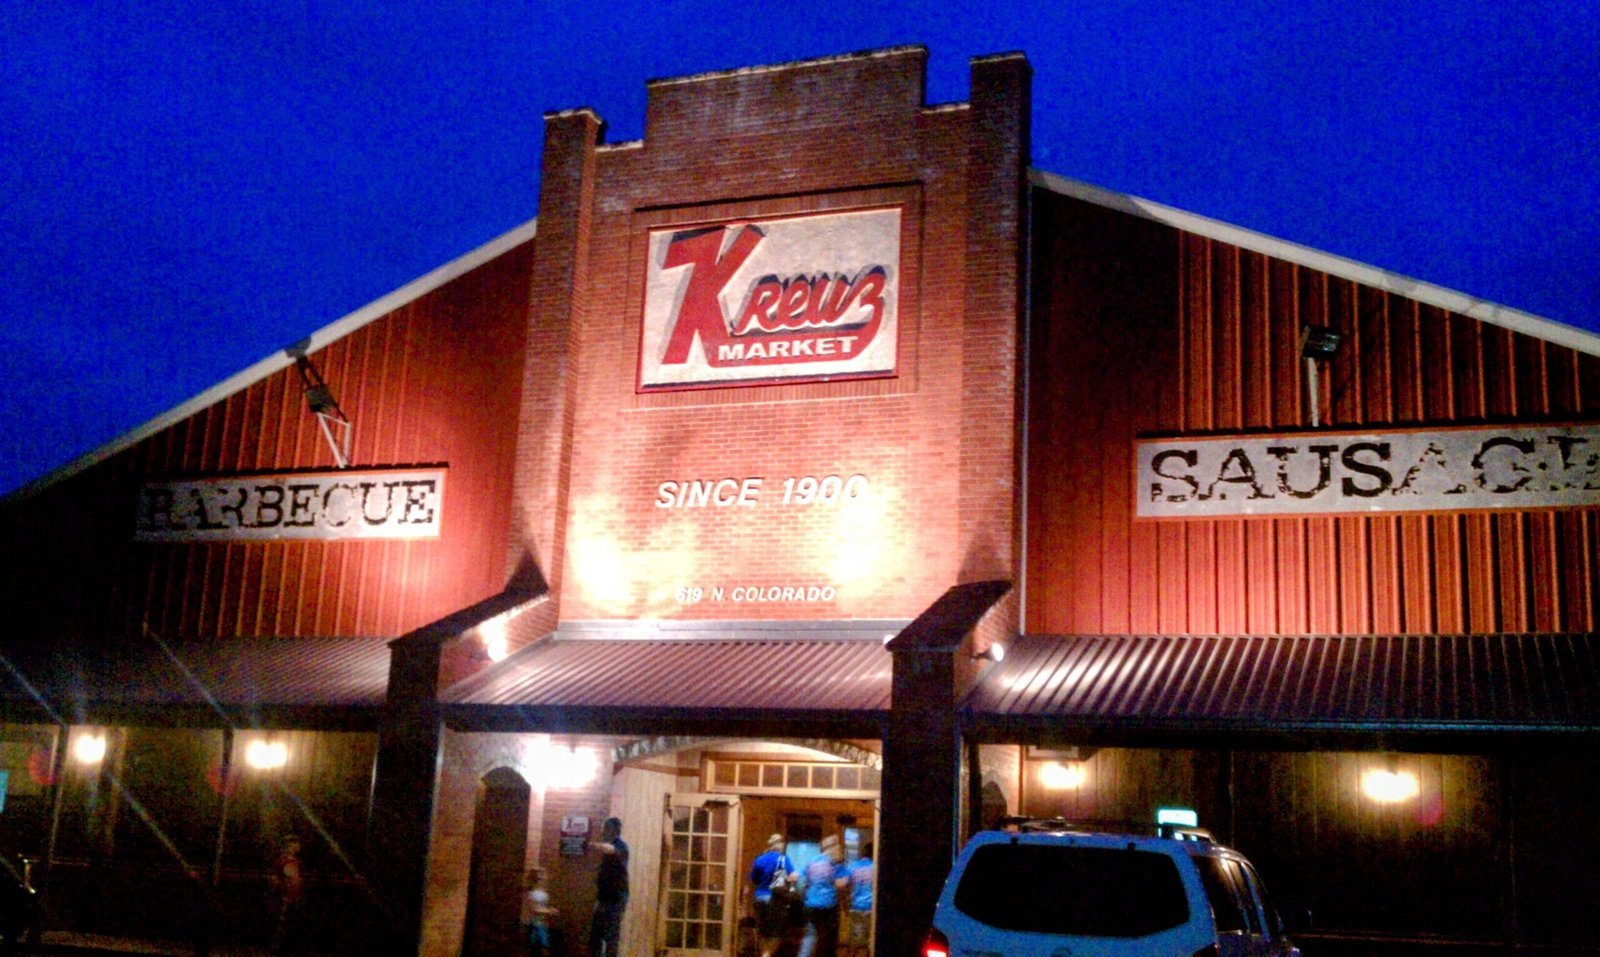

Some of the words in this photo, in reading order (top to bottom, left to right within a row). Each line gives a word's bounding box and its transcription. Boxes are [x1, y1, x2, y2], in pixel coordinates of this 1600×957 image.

[718, 336, 859, 361] MARKET
[655, 477, 764, 508] SINCE
[782, 474, 869, 505] 1900
[675, 586, 704, 603] 619
[731, 585, 837, 602] COLORADO
